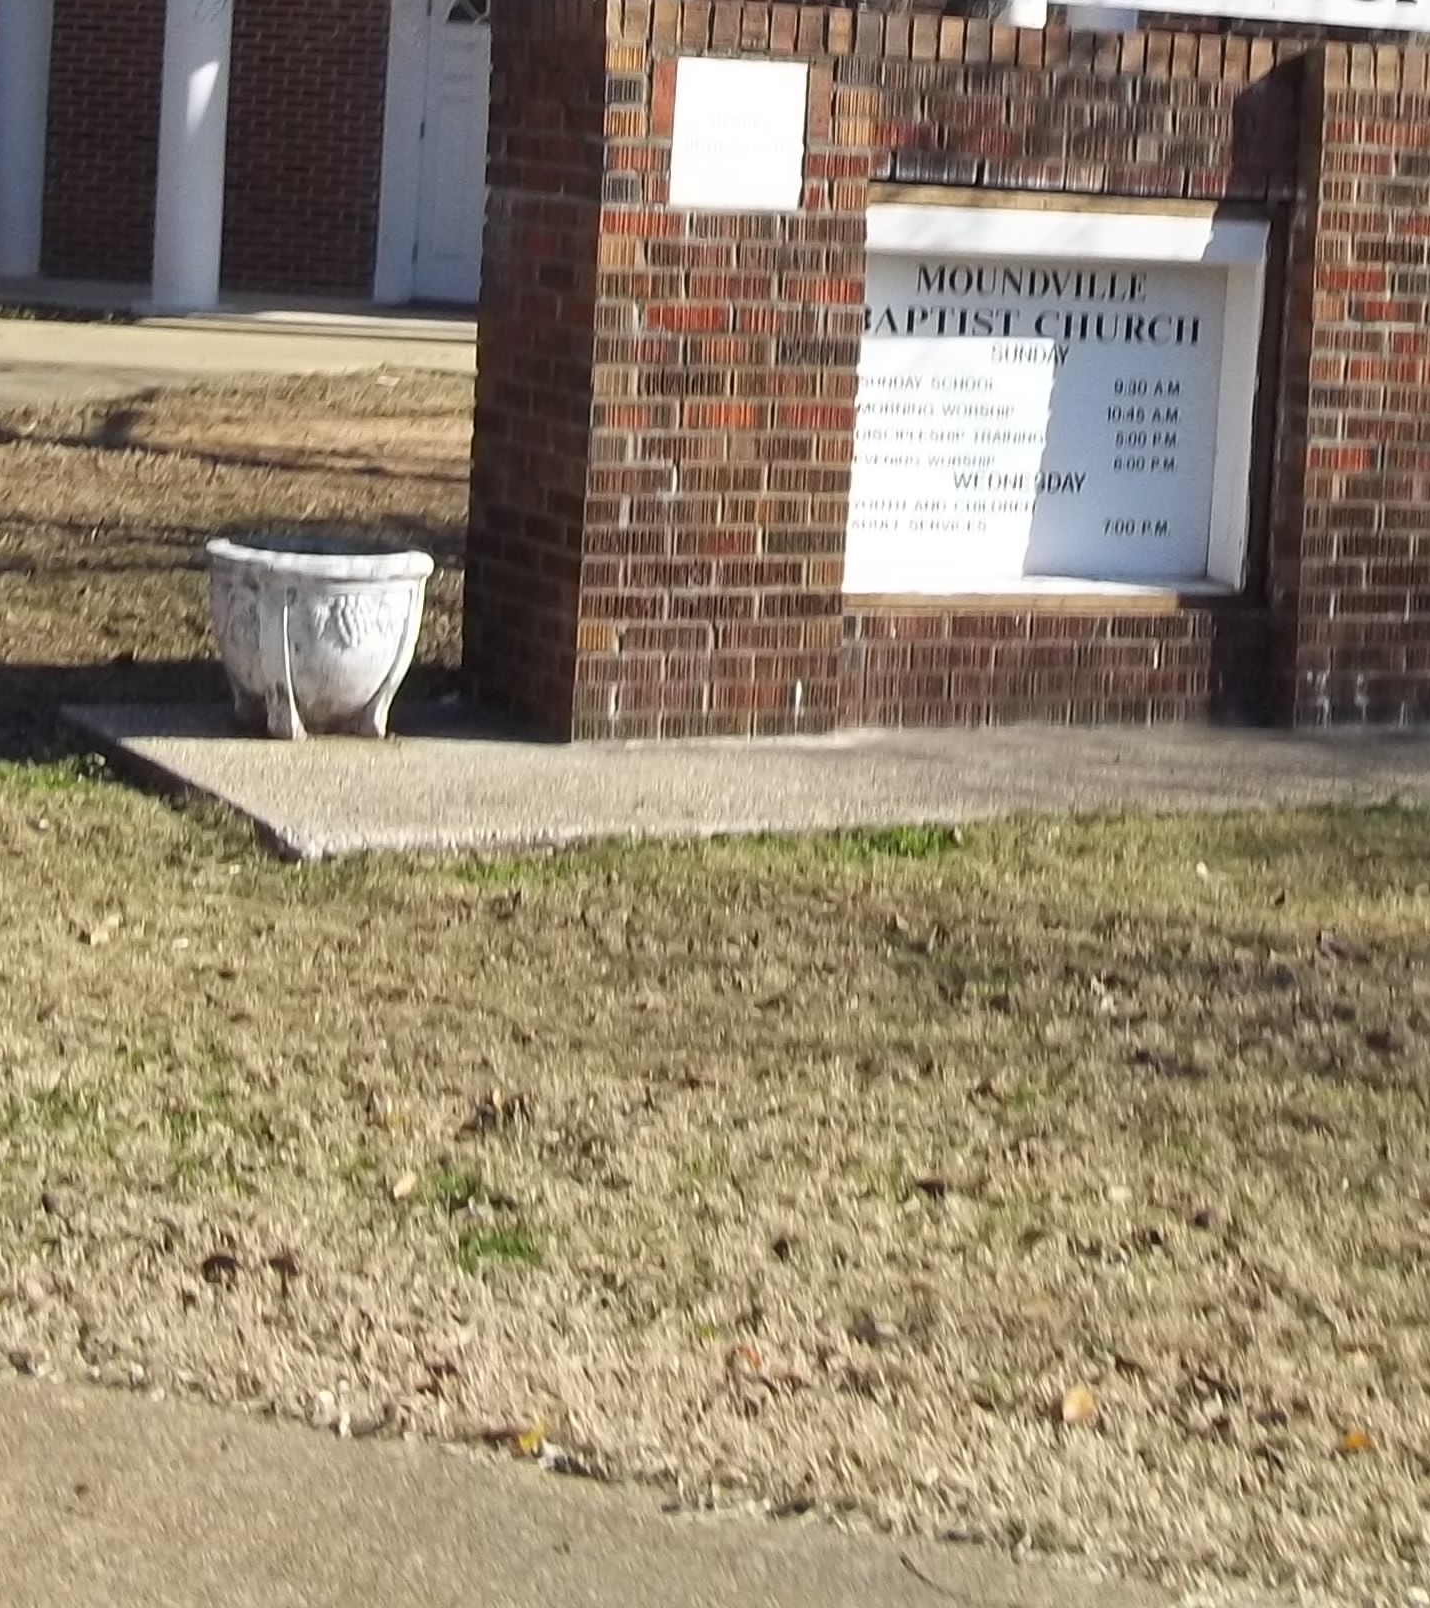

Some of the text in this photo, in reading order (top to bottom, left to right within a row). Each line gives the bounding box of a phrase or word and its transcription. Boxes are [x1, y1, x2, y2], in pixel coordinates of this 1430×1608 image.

[916, 264, 1147, 304] MOUNDVILLE
[1034, 309, 1201, 346] CHURCH
[991, 343, 1069, 368] SUNDAY
[942, 400, 1015, 419] WORSHIP
[953, 471, 1087, 495] WEDNESDAY
